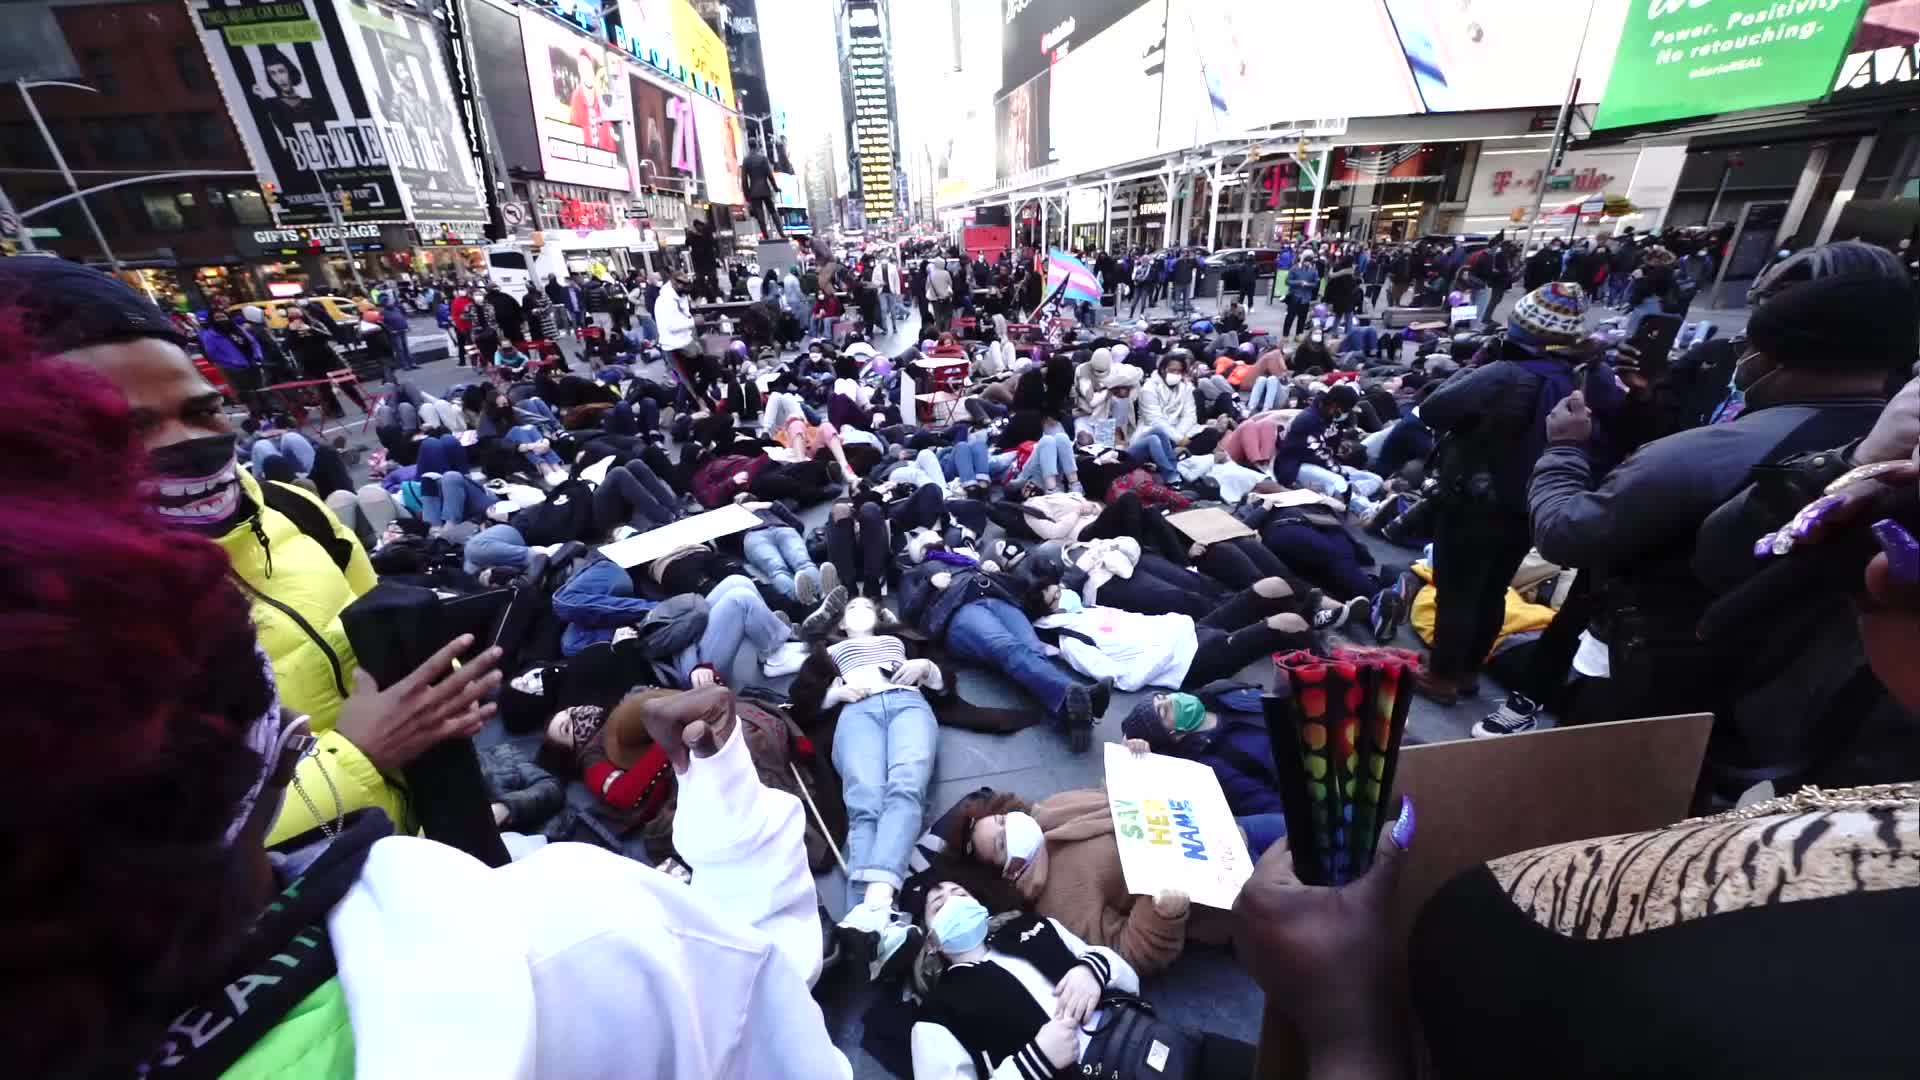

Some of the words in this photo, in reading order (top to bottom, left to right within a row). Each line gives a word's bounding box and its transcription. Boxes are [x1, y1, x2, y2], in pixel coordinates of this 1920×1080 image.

[1655, 48, 1684, 65] No
[253, 230, 300, 244] GIFTS
[307, 226, 381, 241] LUGGAGE
[1113, 798, 1145, 840] SAY
[1142, 798, 1173, 845] HER
[1167, 797, 1209, 861] NAME
